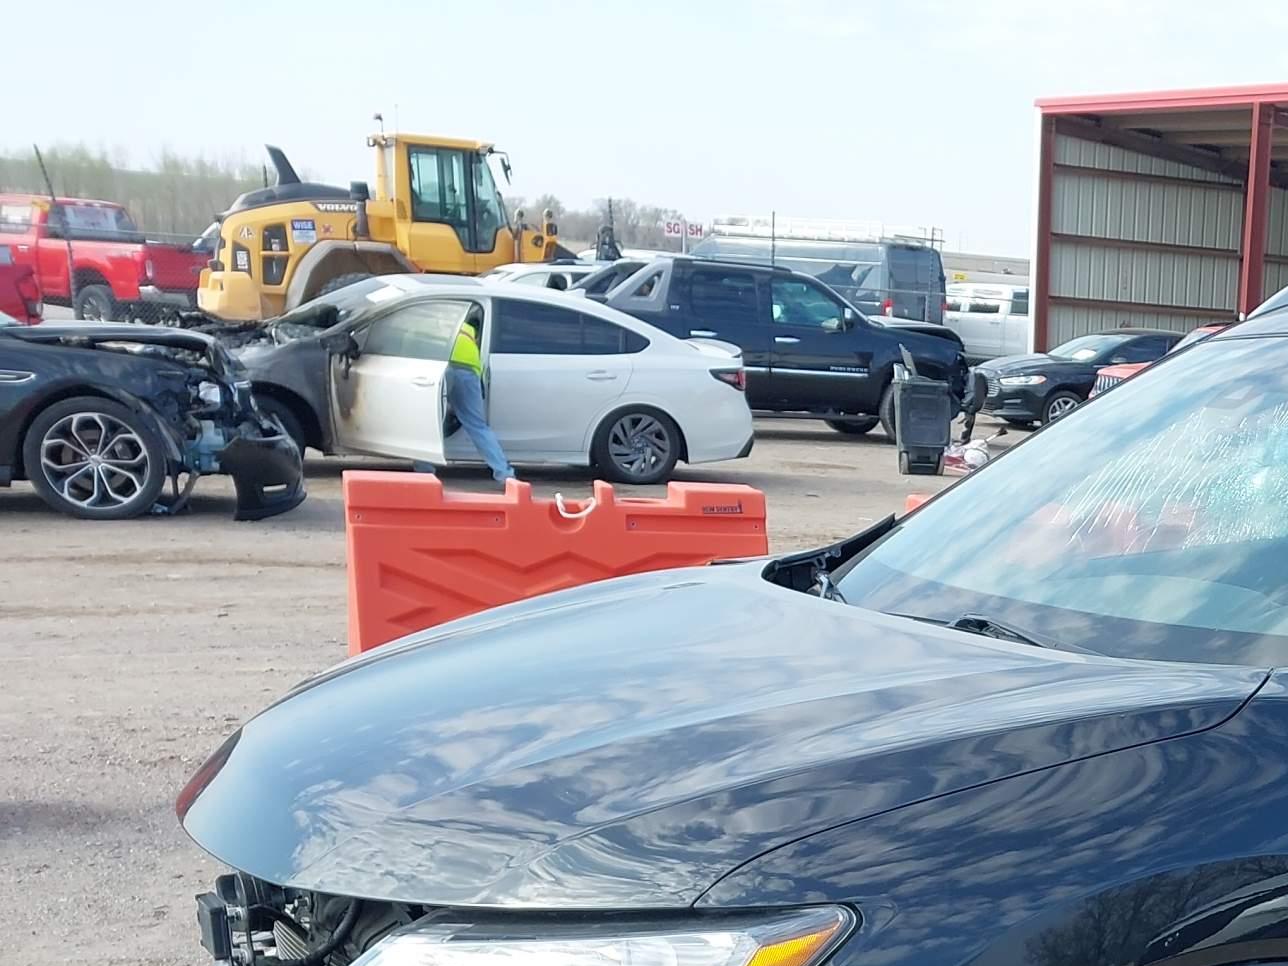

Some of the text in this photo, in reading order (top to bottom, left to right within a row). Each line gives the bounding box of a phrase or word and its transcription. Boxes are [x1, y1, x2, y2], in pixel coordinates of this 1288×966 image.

[317, 203, 358, 211] VOLVO
[666, 222, 681, 234] SG
[688, 224, 703, 236] SH
